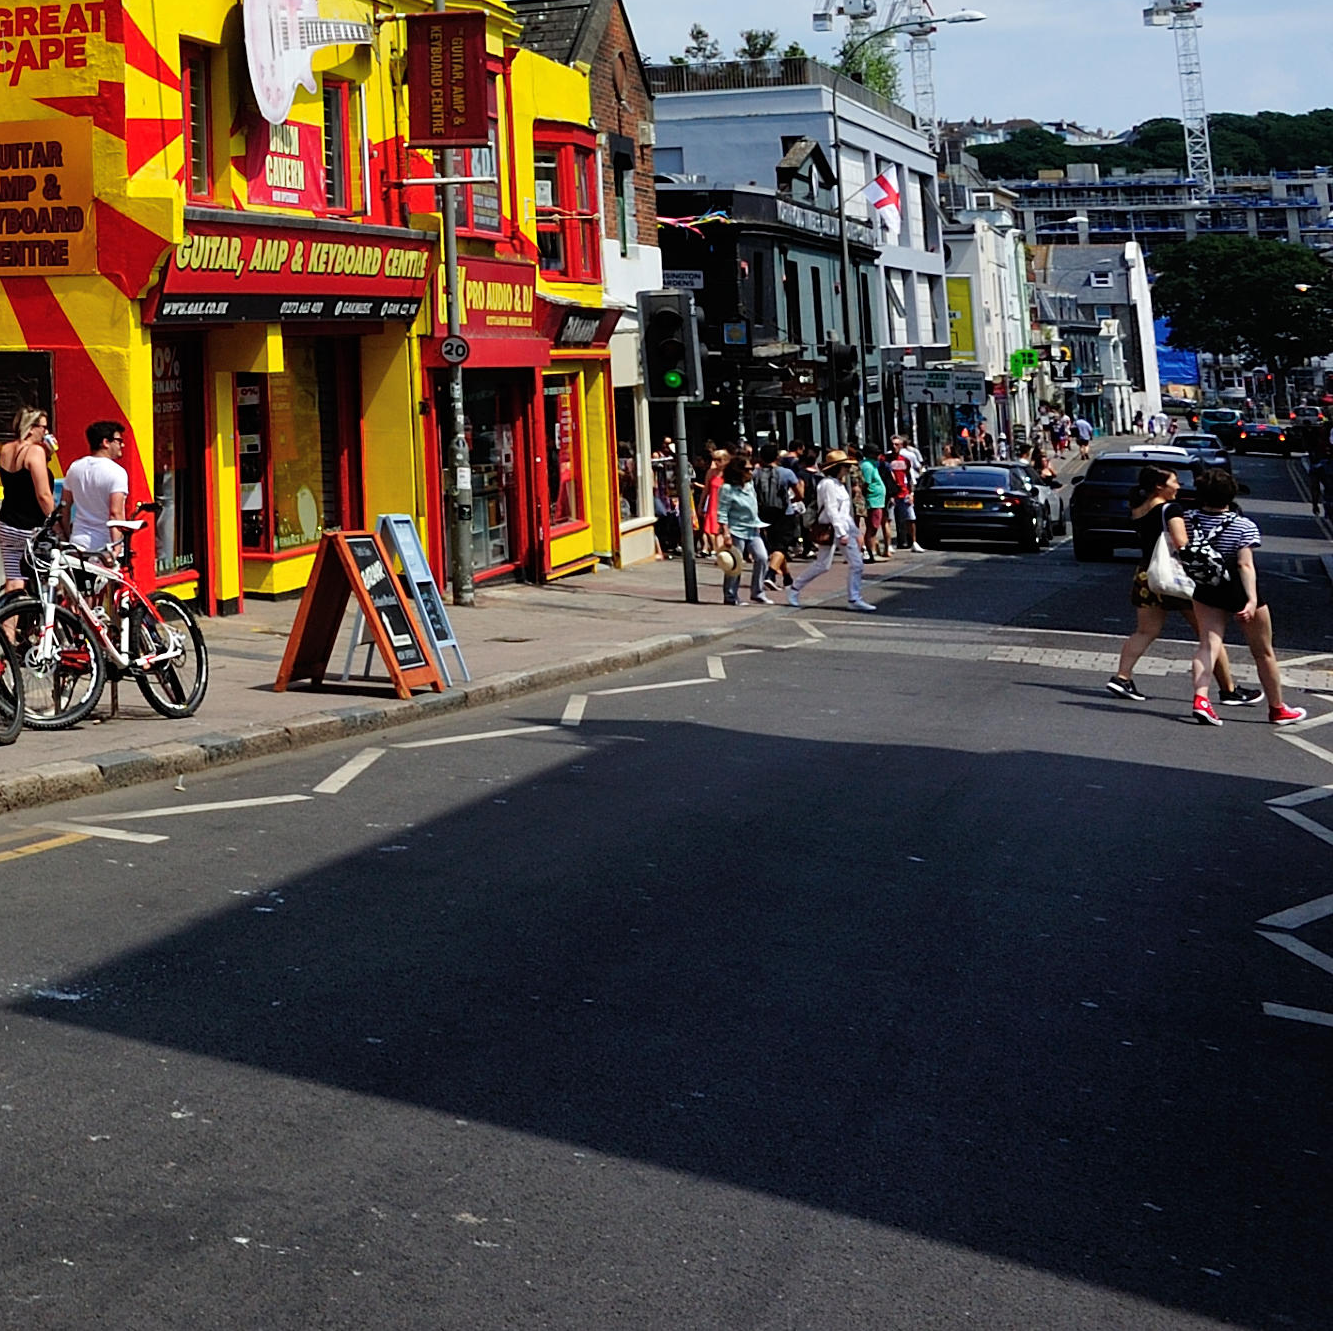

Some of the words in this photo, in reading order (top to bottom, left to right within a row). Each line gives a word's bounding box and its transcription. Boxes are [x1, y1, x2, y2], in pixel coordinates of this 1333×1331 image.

[430, 26, 445, 87] KEYBOARD
[450, 37, 464, 83] GUITAR,
[431, 89, 445, 135] CENTRE
[452, 85, 466, 115] AMP
[453, 117, 466, 126] &
[42, 173, 62, 201] &
[265, 154, 305, 191] CAVERN
[175, 235, 246, 276] GUITAR,
[248, 238, 289, 271] AMP
[290, 240, 304, 272] &
[307, 242, 382, 276] KEYBOARD
[384, 248, 429, 278] CENTRE
[466, 280, 485, 310] PRO
[486, 282, 513, 312] AUDIO
[514, 284, 522, 312] &
[522, 285, 533, 313] DJ
[154, 347, 180, 378] 0%
[444, 342, 466, 358] 20
